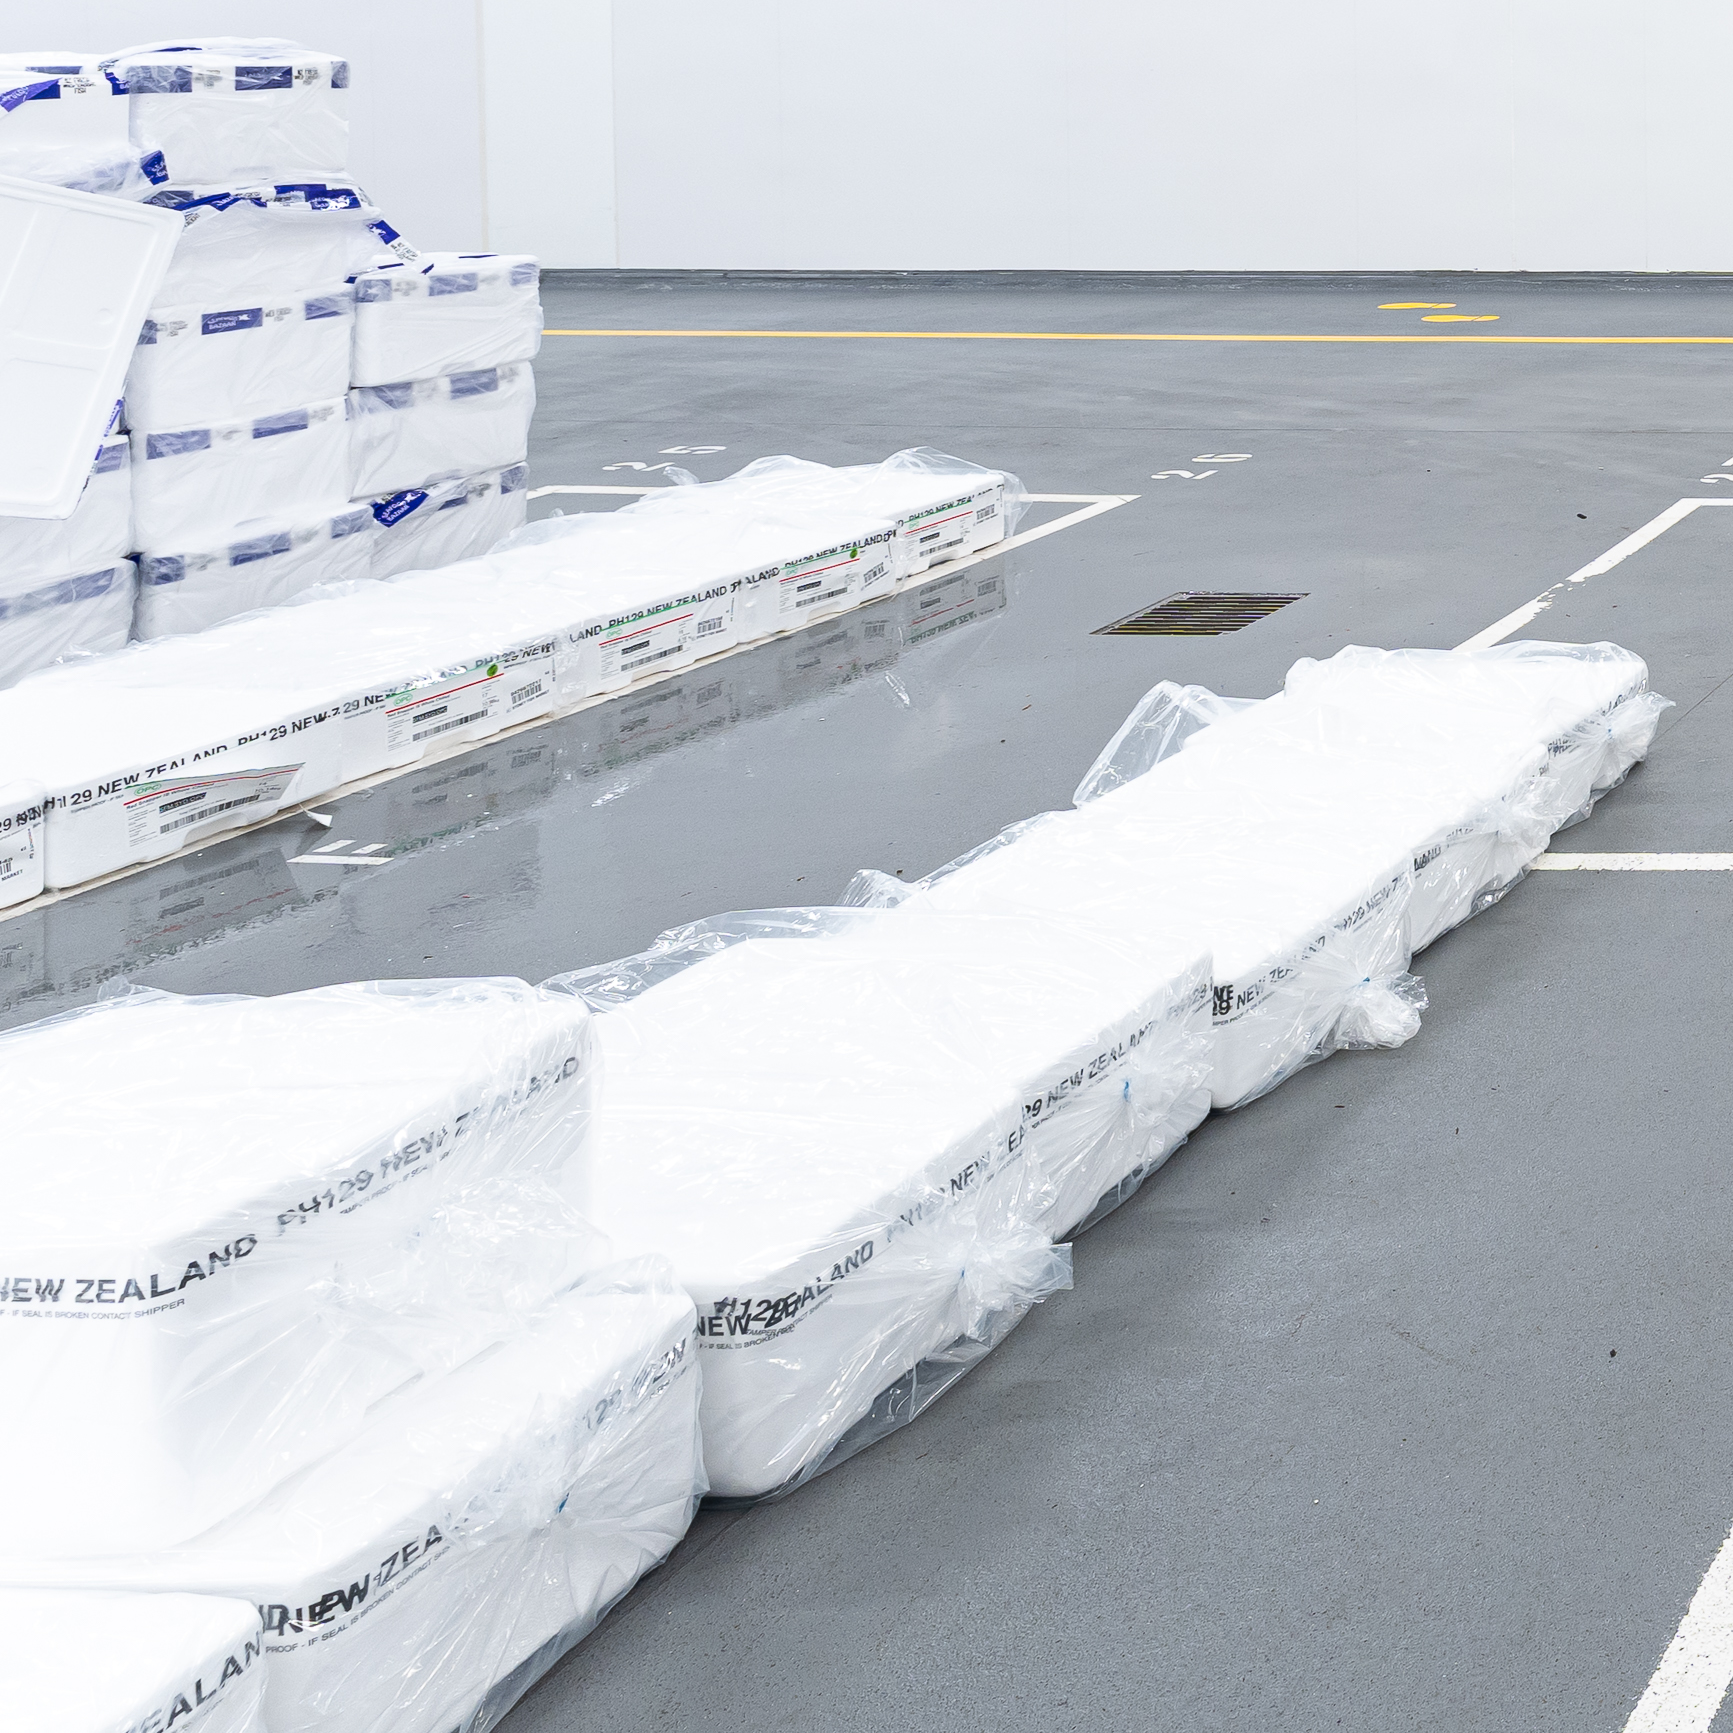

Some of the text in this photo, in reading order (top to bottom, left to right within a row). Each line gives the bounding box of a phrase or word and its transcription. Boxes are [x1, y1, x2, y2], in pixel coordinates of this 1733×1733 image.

[1150, 453, 1253, 480] 26
[97, 771, 141, 797] NEW
[136, 782, 162, 795] OPC
[1046, 1067, 1085, 1107] NEW
[75, 1233, 259, 1304] ZEALAND
[21, 1309, 44, 1318] SEAL
[54, 1310, 90, 1319] BROKEN
[91, 1311, 132, 1320] CONTACT
[133, 1298, 186, 1319] SHIPPER
[716, 1342, 733, 1350] SEAL
[265, 1642, 299, 1655] PROOF
[307, 1636, 320, 1648] IF
[321, 1623, 349, 1643] SEAL
[360, 1587, 395, 1617] BROKEN
